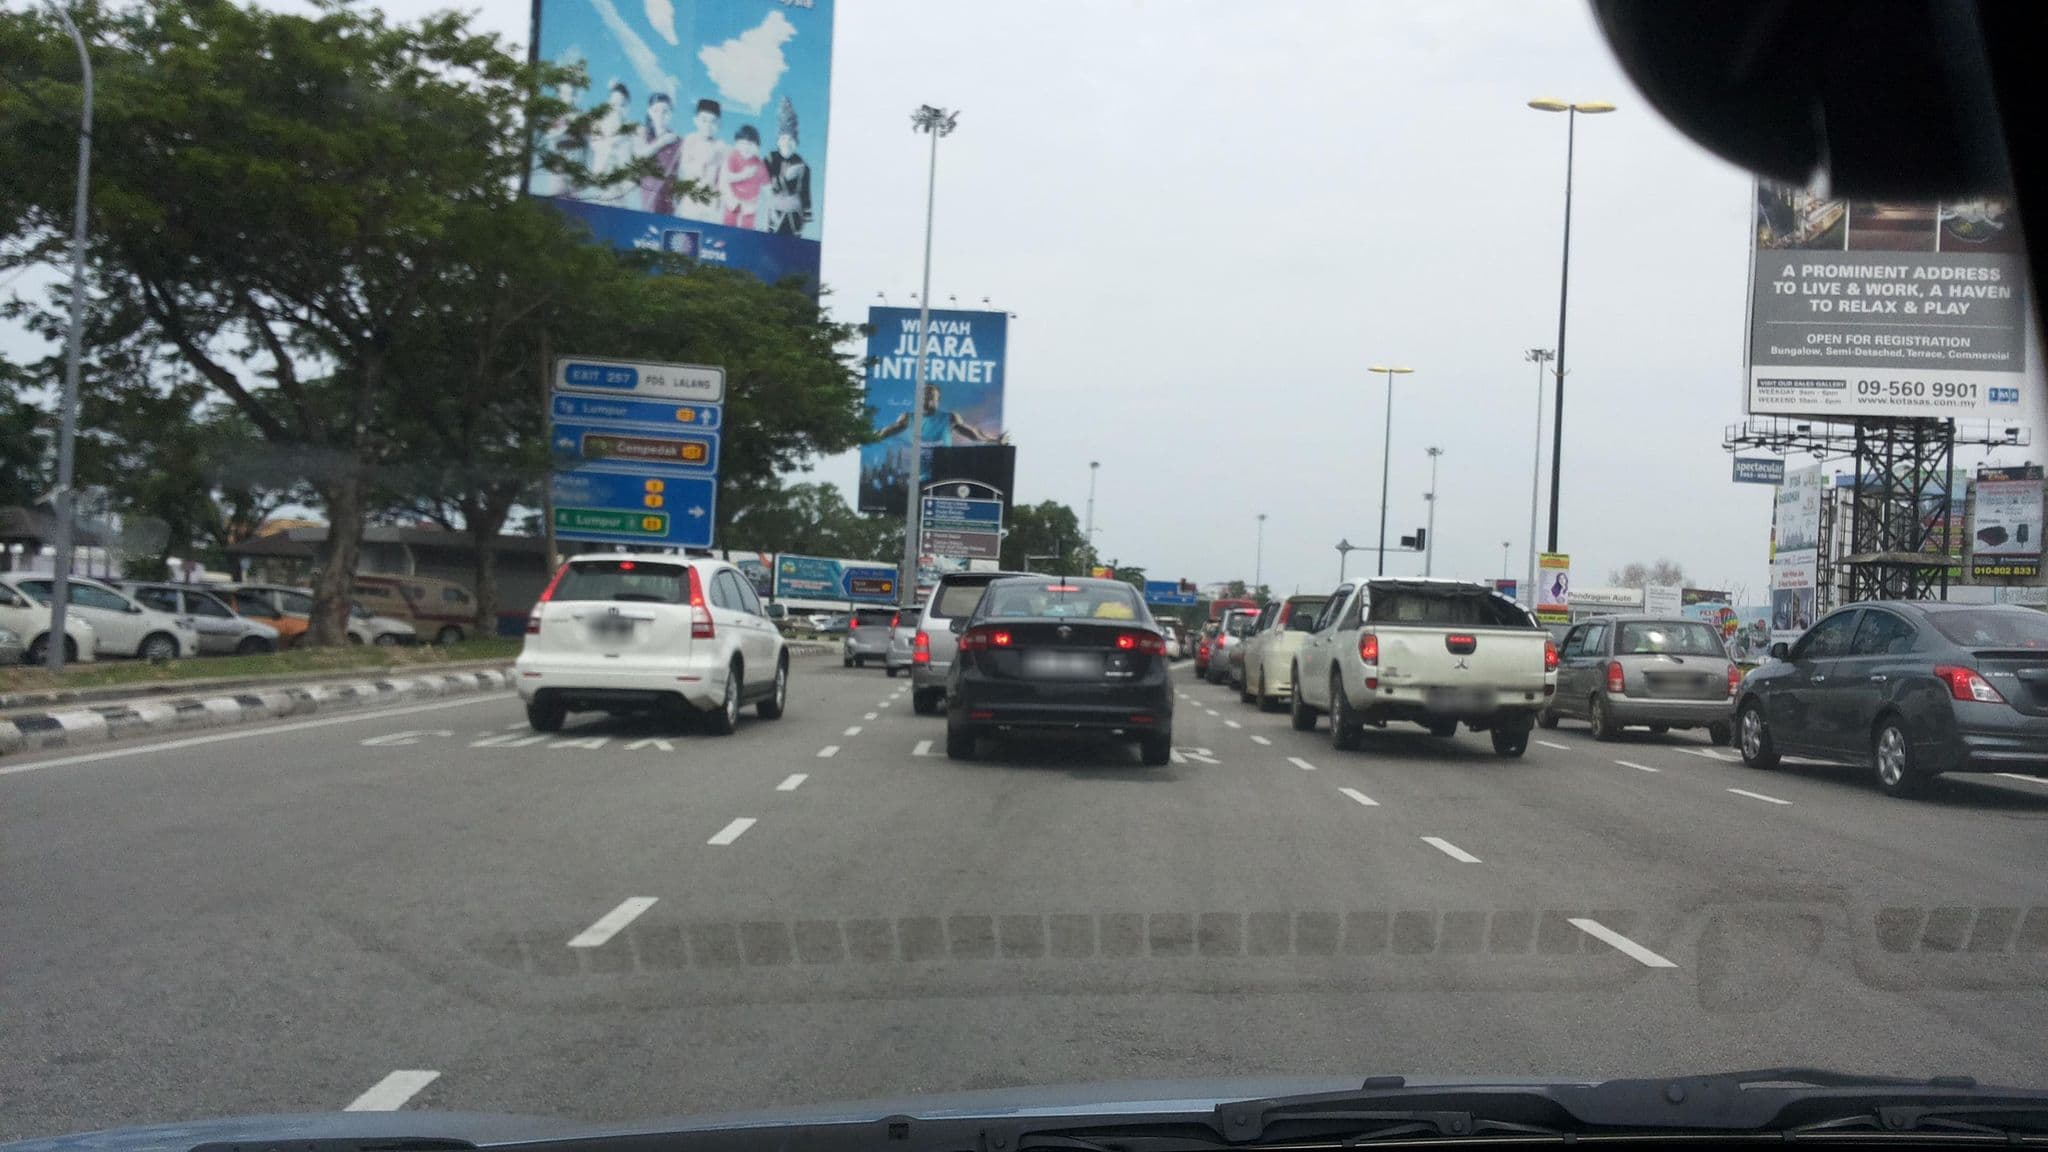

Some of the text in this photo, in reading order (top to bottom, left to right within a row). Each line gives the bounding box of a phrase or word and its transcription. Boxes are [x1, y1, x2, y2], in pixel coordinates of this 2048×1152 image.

[1782, 264, 2001, 281] A PROMINENT ADDRESS
[1773, 281, 2011, 299] TO LIVE & WORK, A HAVEN
[1809, 299, 1970, 315] TO RELAX & PLAY
[901, 319, 971, 335] WIAYAH
[894, 334, 978, 358] JUARA
[1806, 333, 1971, 348] OPEN FOR REGISTRATION
[1770, 346, 1823, 357] Bungalow,
[1948, 350, 2009, 360] Commercial
[572, 369, 600, 382] EXIT
[673, 376, 712, 390] LALANG
[1857, 380, 1977, 398] 09-560 9901
[1857, 396, 1976, 408] www.kotasas.com.my
[1736, 462, 1784, 477] spectacular
[576, 514, 621, 529] Lumpur
[1567, 591, 1632, 602] Pendragon Auto
